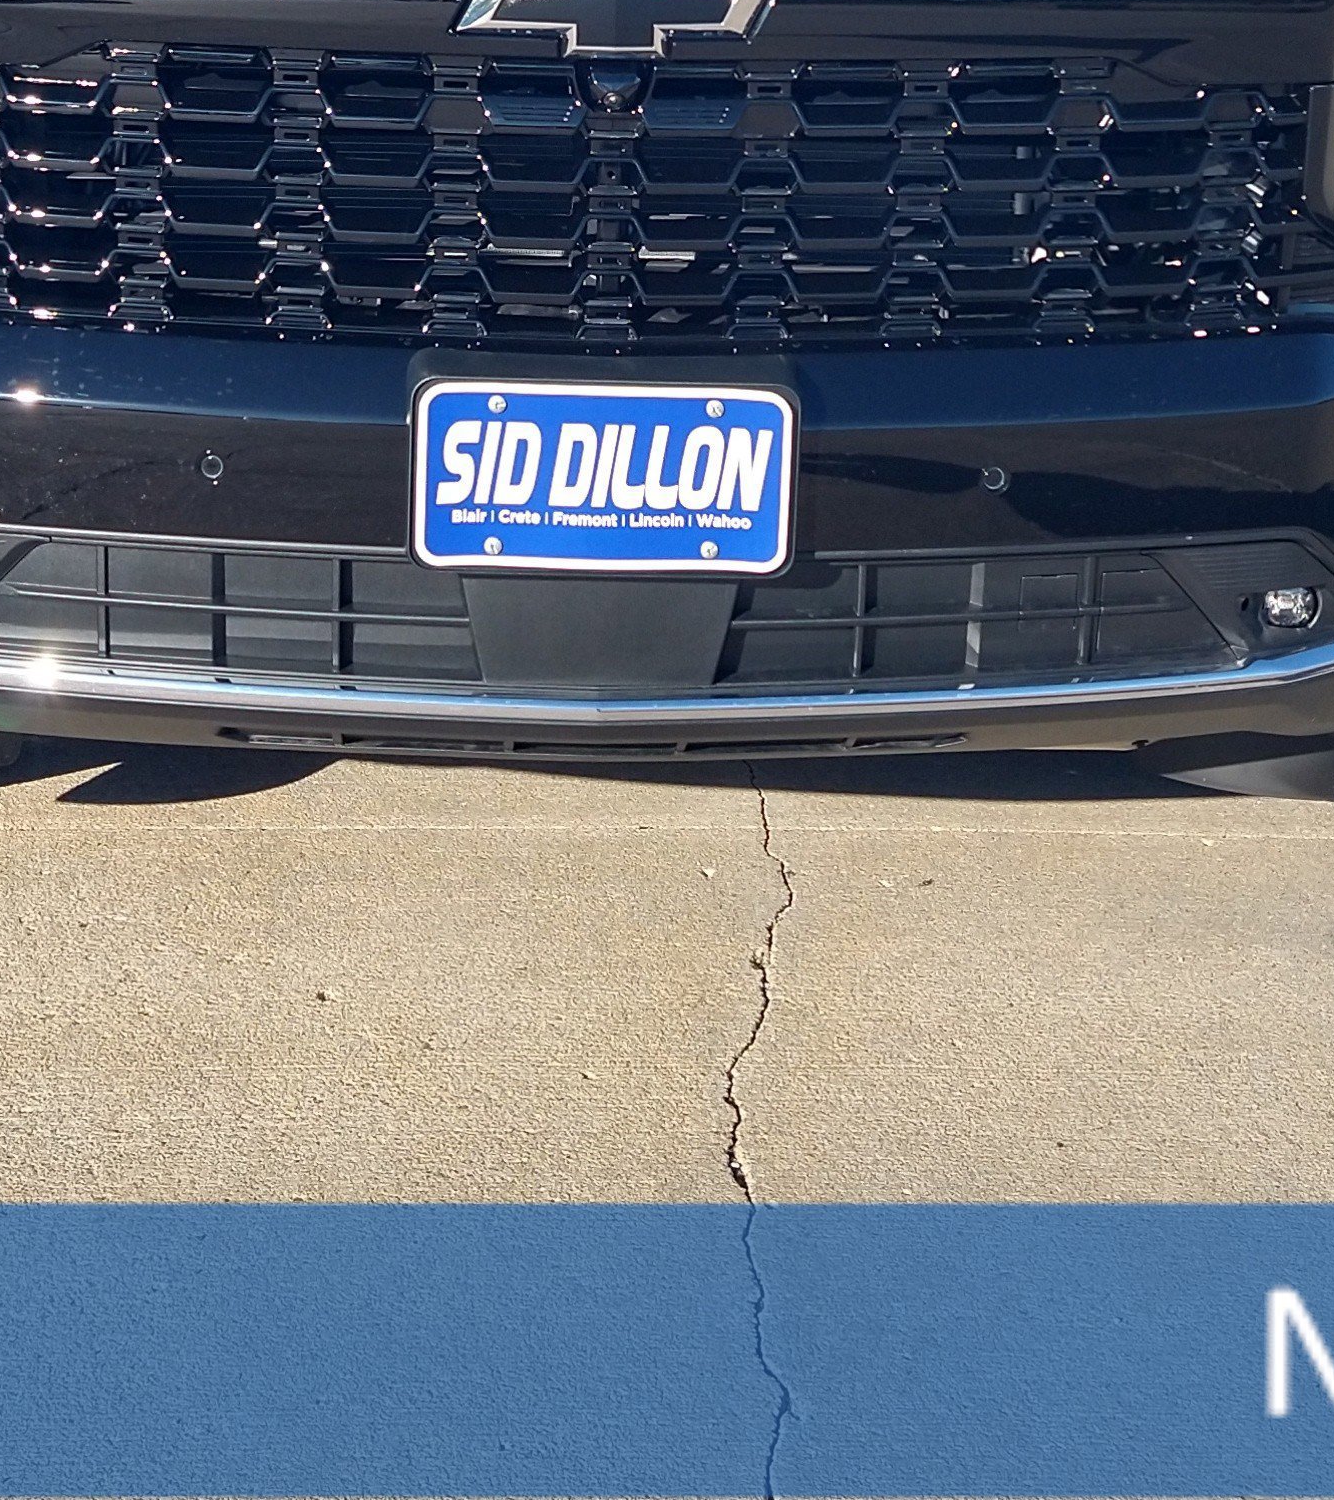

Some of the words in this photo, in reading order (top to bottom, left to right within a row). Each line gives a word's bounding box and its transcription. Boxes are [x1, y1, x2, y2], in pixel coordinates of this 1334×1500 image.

[436, 420, 542, 505] SID
[548, 422, 774, 512] DILLON
[451, 508, 487, 524] Blair
[498, 509, 542, 525] Crete
[552, 511, 618, 527] Fremont
[629, 512, 685, 528] Lincoln
[695, 513, 753, 530] Wahoo
